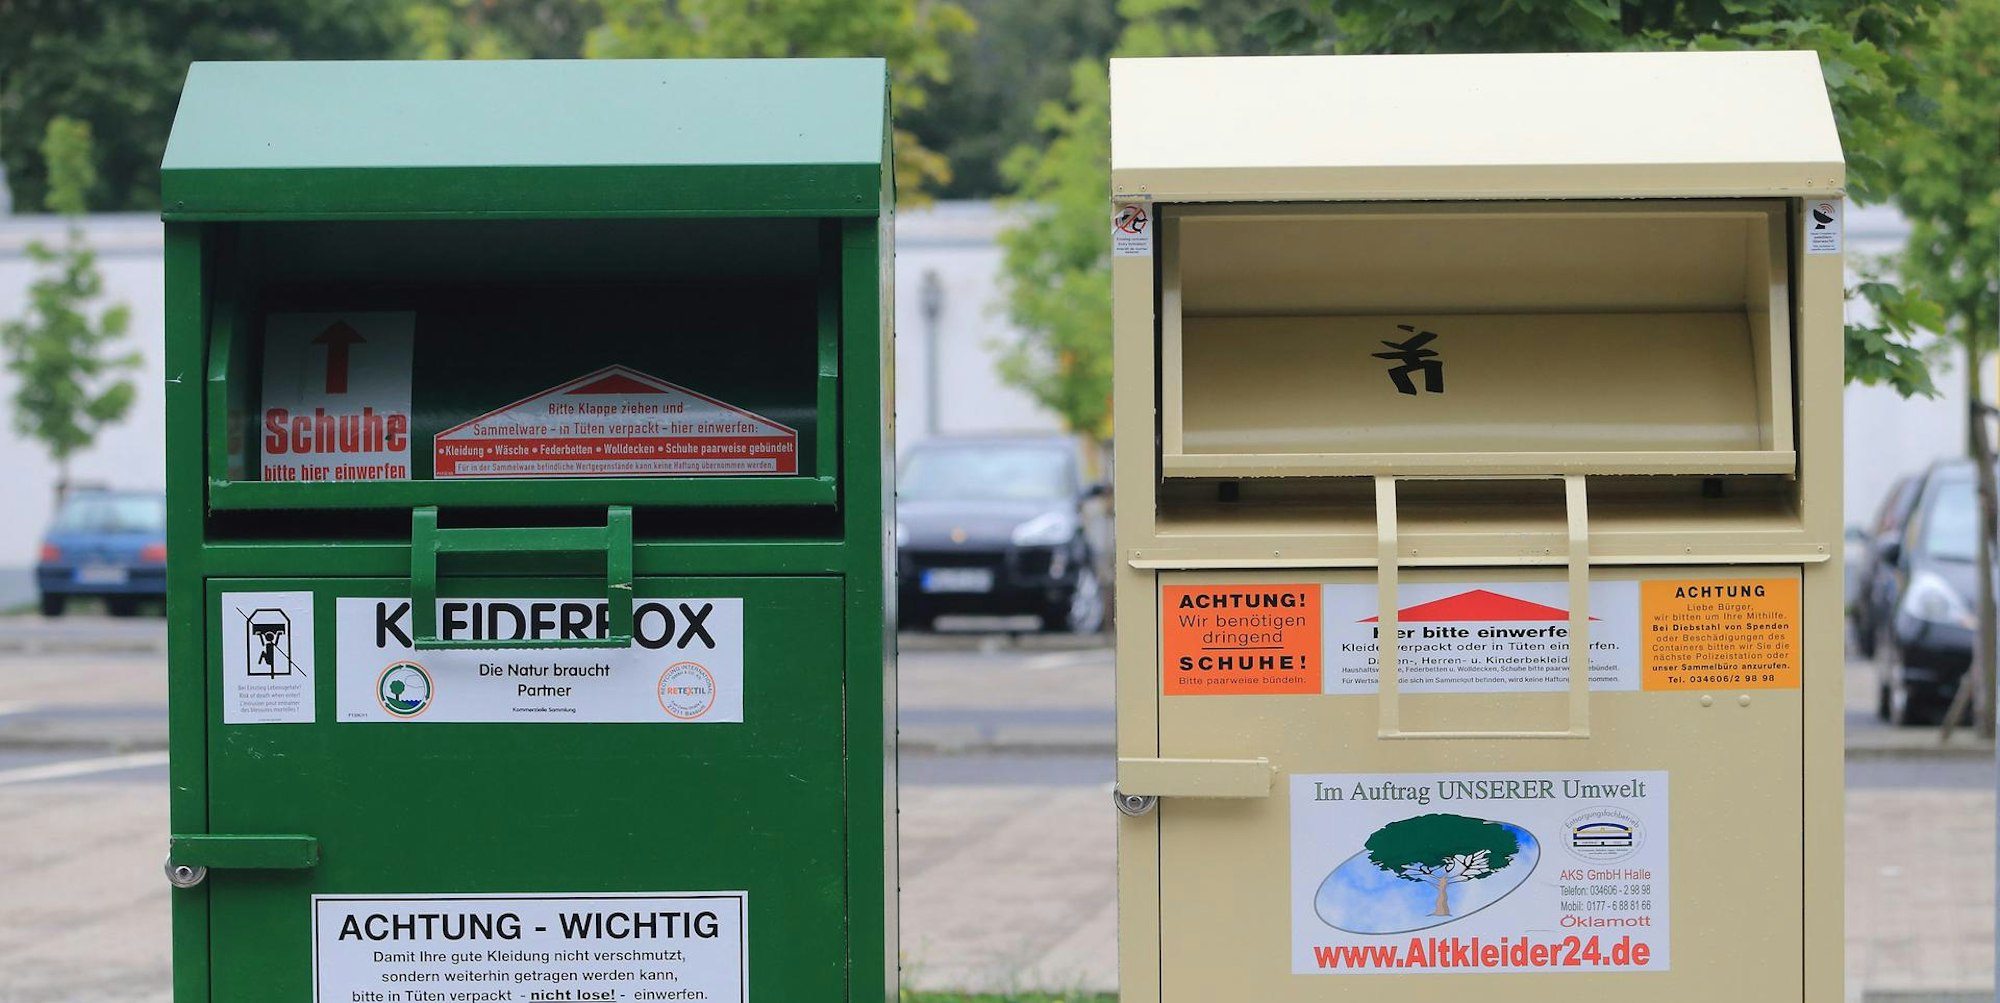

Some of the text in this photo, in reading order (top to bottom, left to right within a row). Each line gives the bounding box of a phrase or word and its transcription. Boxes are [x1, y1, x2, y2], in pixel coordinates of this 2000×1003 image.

[548, 402, 684, 416] Bitte Klappe ziehen und
[265, 407, 407, 454] Schuhe
[474, 421, 758, 438] Sammelware in Tüten verpackt hier einwerfen:
[445, 442, 793, 458] Kleidung Wäsche Federbetten Wolldecken Schuhe paarweise gebündelt
[264, 463, 406, 482] bitte hier einwerfen
[458, 464, 470, 472] Für
[479, 463, 490, 472] der
[492, 462, 536, 472] Sammelware
[537, 462, 574, 471] befindliche
[635, 462, 652, 470] kann
[654, 461, 672, 470] keine
[674, 461, 700, 470] Haftung
[702, 460, 745, 470] übernommen
[1675, 585, 1765, 598] ACHTUNG
[1179, 593, 1306, 609] ACHTUNG!
[1687, 603, 1754, 612] Liebe Bürger,
[1179, 614, 1306, 630] Wir benötigen
[1672, 613, 1701, 621] bitten
[1746, 612, 1787, 620] Mithilfe.
[1423, 626, 1570, 639] bitte einwerfe
[1672, 623, 1720, 631] Diebstahl
[1746, 623, 1789, 631] Spenden
[1202, 631, 1283, 646] dringend
[1682, 633, 1764, 642] Beschädigungen
[1456, 643, 1487, 651] oder
[1492, 642, 1503, 650] in
[1508, 642, 1545, 650] Tüten
[1550, 641, 1620, 650] einrfen.
[1652, 644, 1704, 652] Containers
[1707, 643, 1735, 651] bitten
[1756, 642, 1771, 650] Sie
[1653, 653, 1691, 661] nächste
[1696, 652, 1763, 660] Polizeistation
[479, 663, 610, 676] Die Natur braucht
[1180, 656, 1306, 671] SCHUHE!
[1681, 663, 1738, 671] Sammelbüro
[1741, 662, 1790, 670] anzurufen.
[1179, 676, 1306, 686] Bitte paarweise bündeln.
[1668, 674, 1775, 684] Tel. 034606/2 98 98
[518, 684, 572, 696] Partner
[548, 706, 576, 714] Sammlung
[1314, 779, 1646, 805] Im Auftrag UNSERER Umwelt
[1565, 809, 1640, 829] Entsorgungsfachbetrieb
[1560, 869, 1650, 880] AKS GmbH Halle
[1560, 884, 1650, 896] Telefon: 034606 2 98 98
[1561, 900, 1651, 911] Mobil: 0177 6 88 81 66
[338, 912, 719, 940] ACHTUNG WICHTIG
[1560, 915, 1650, 927] Öklamott
[373, 950, 686, 964] Damit Ihre gute Kleidung nicht verschmutzt,
[1314, 935, 1650, 968] www.Altkleider24.de
[382, 969, 678, 984] sondern weiterhin getragen werden kann,
[352, 988, 708, 1003] bitte in Tüten verpackt nicht lose! einwerfen.
